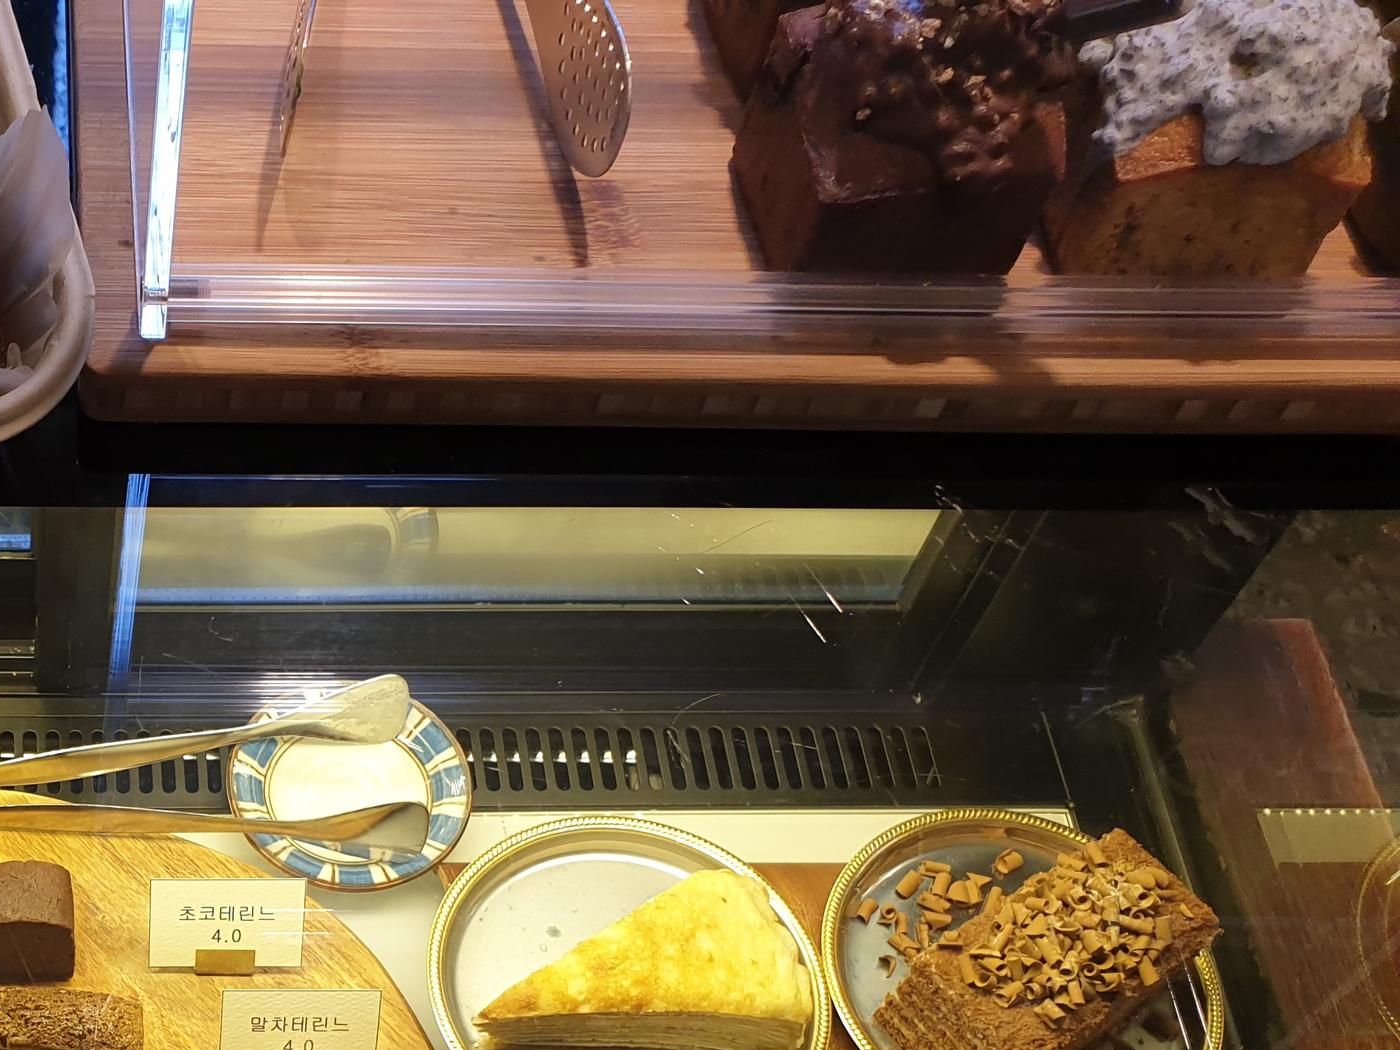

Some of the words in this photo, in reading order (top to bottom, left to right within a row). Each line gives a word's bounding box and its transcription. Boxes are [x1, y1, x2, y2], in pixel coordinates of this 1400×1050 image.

[179, 905, 274, 922] 초코테린느
[211, 928, 242, 944] 4.0
[250, 1016, 349, 1034] 말차테린느
